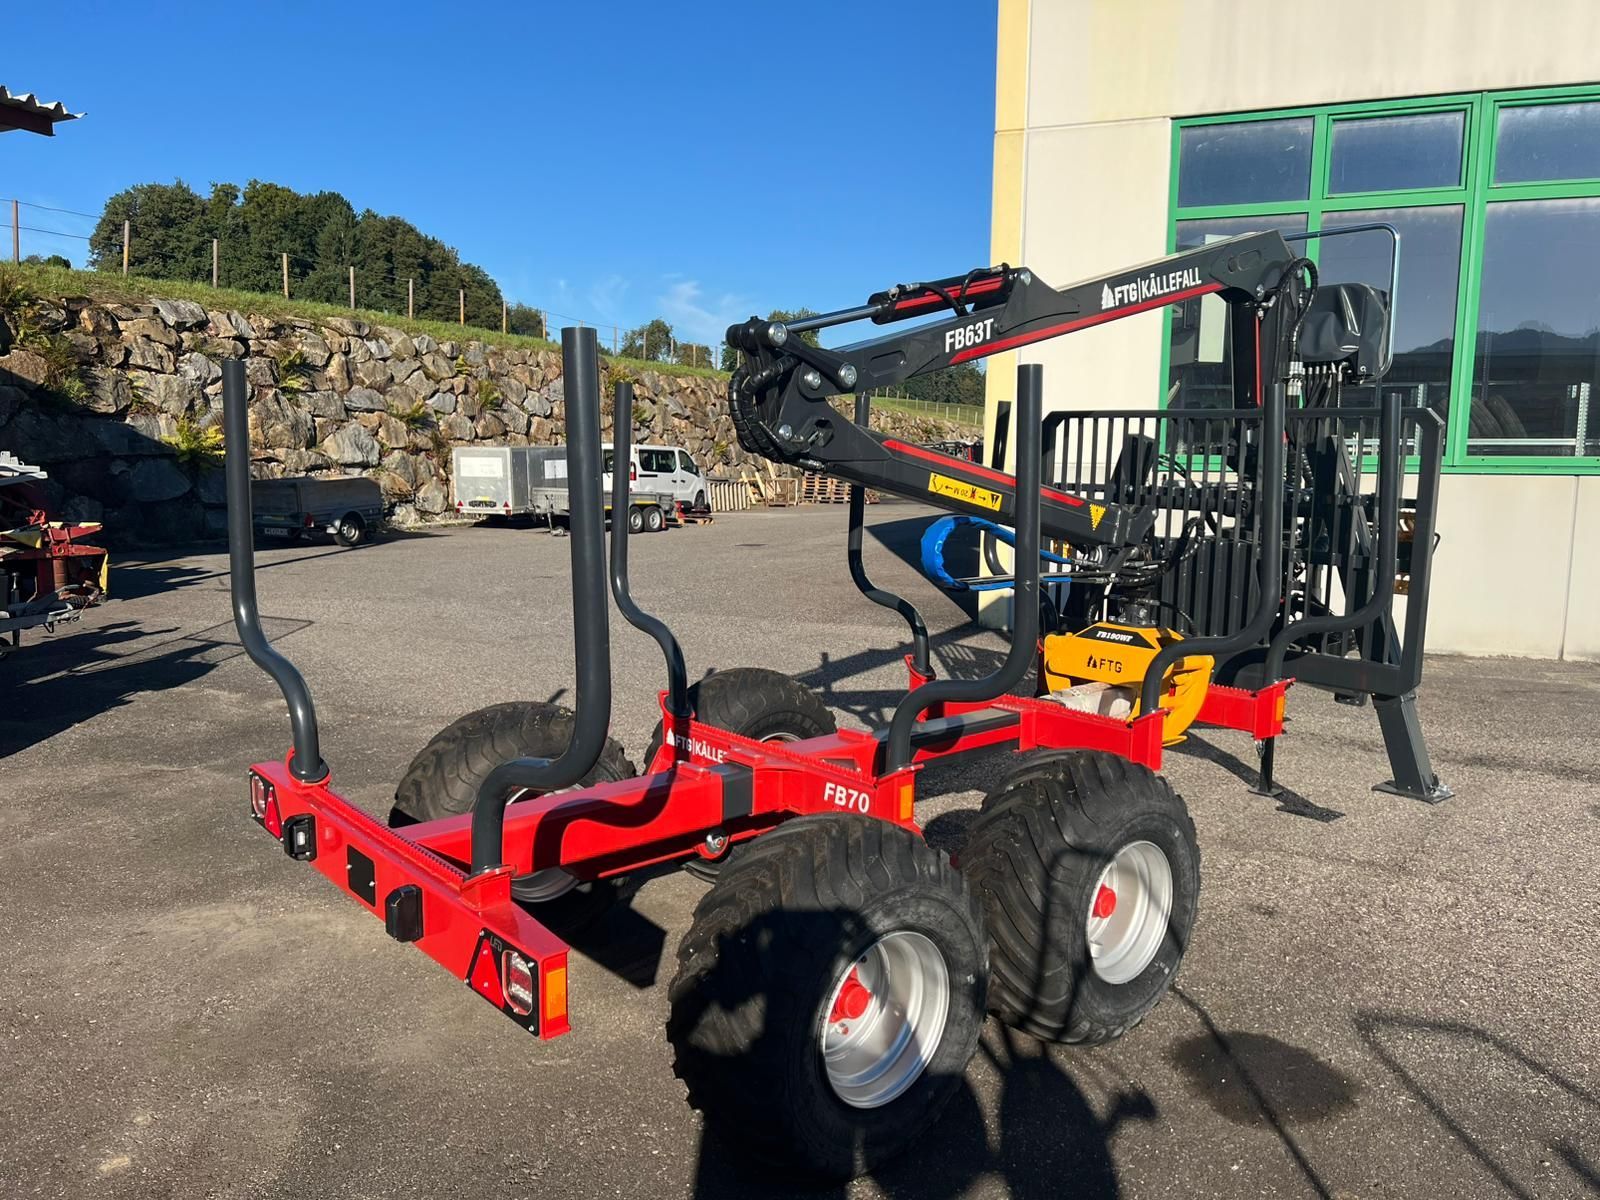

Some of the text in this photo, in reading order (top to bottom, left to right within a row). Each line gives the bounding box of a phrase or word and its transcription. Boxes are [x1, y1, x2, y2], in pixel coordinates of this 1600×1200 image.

[1113, 267, 1202, 306] FTG KÄLLEFALL
[945, 318, 994, 353] FB63T
[1099, 658, 1123, 674] FTG
[823, 781, 870, 813] FB70
